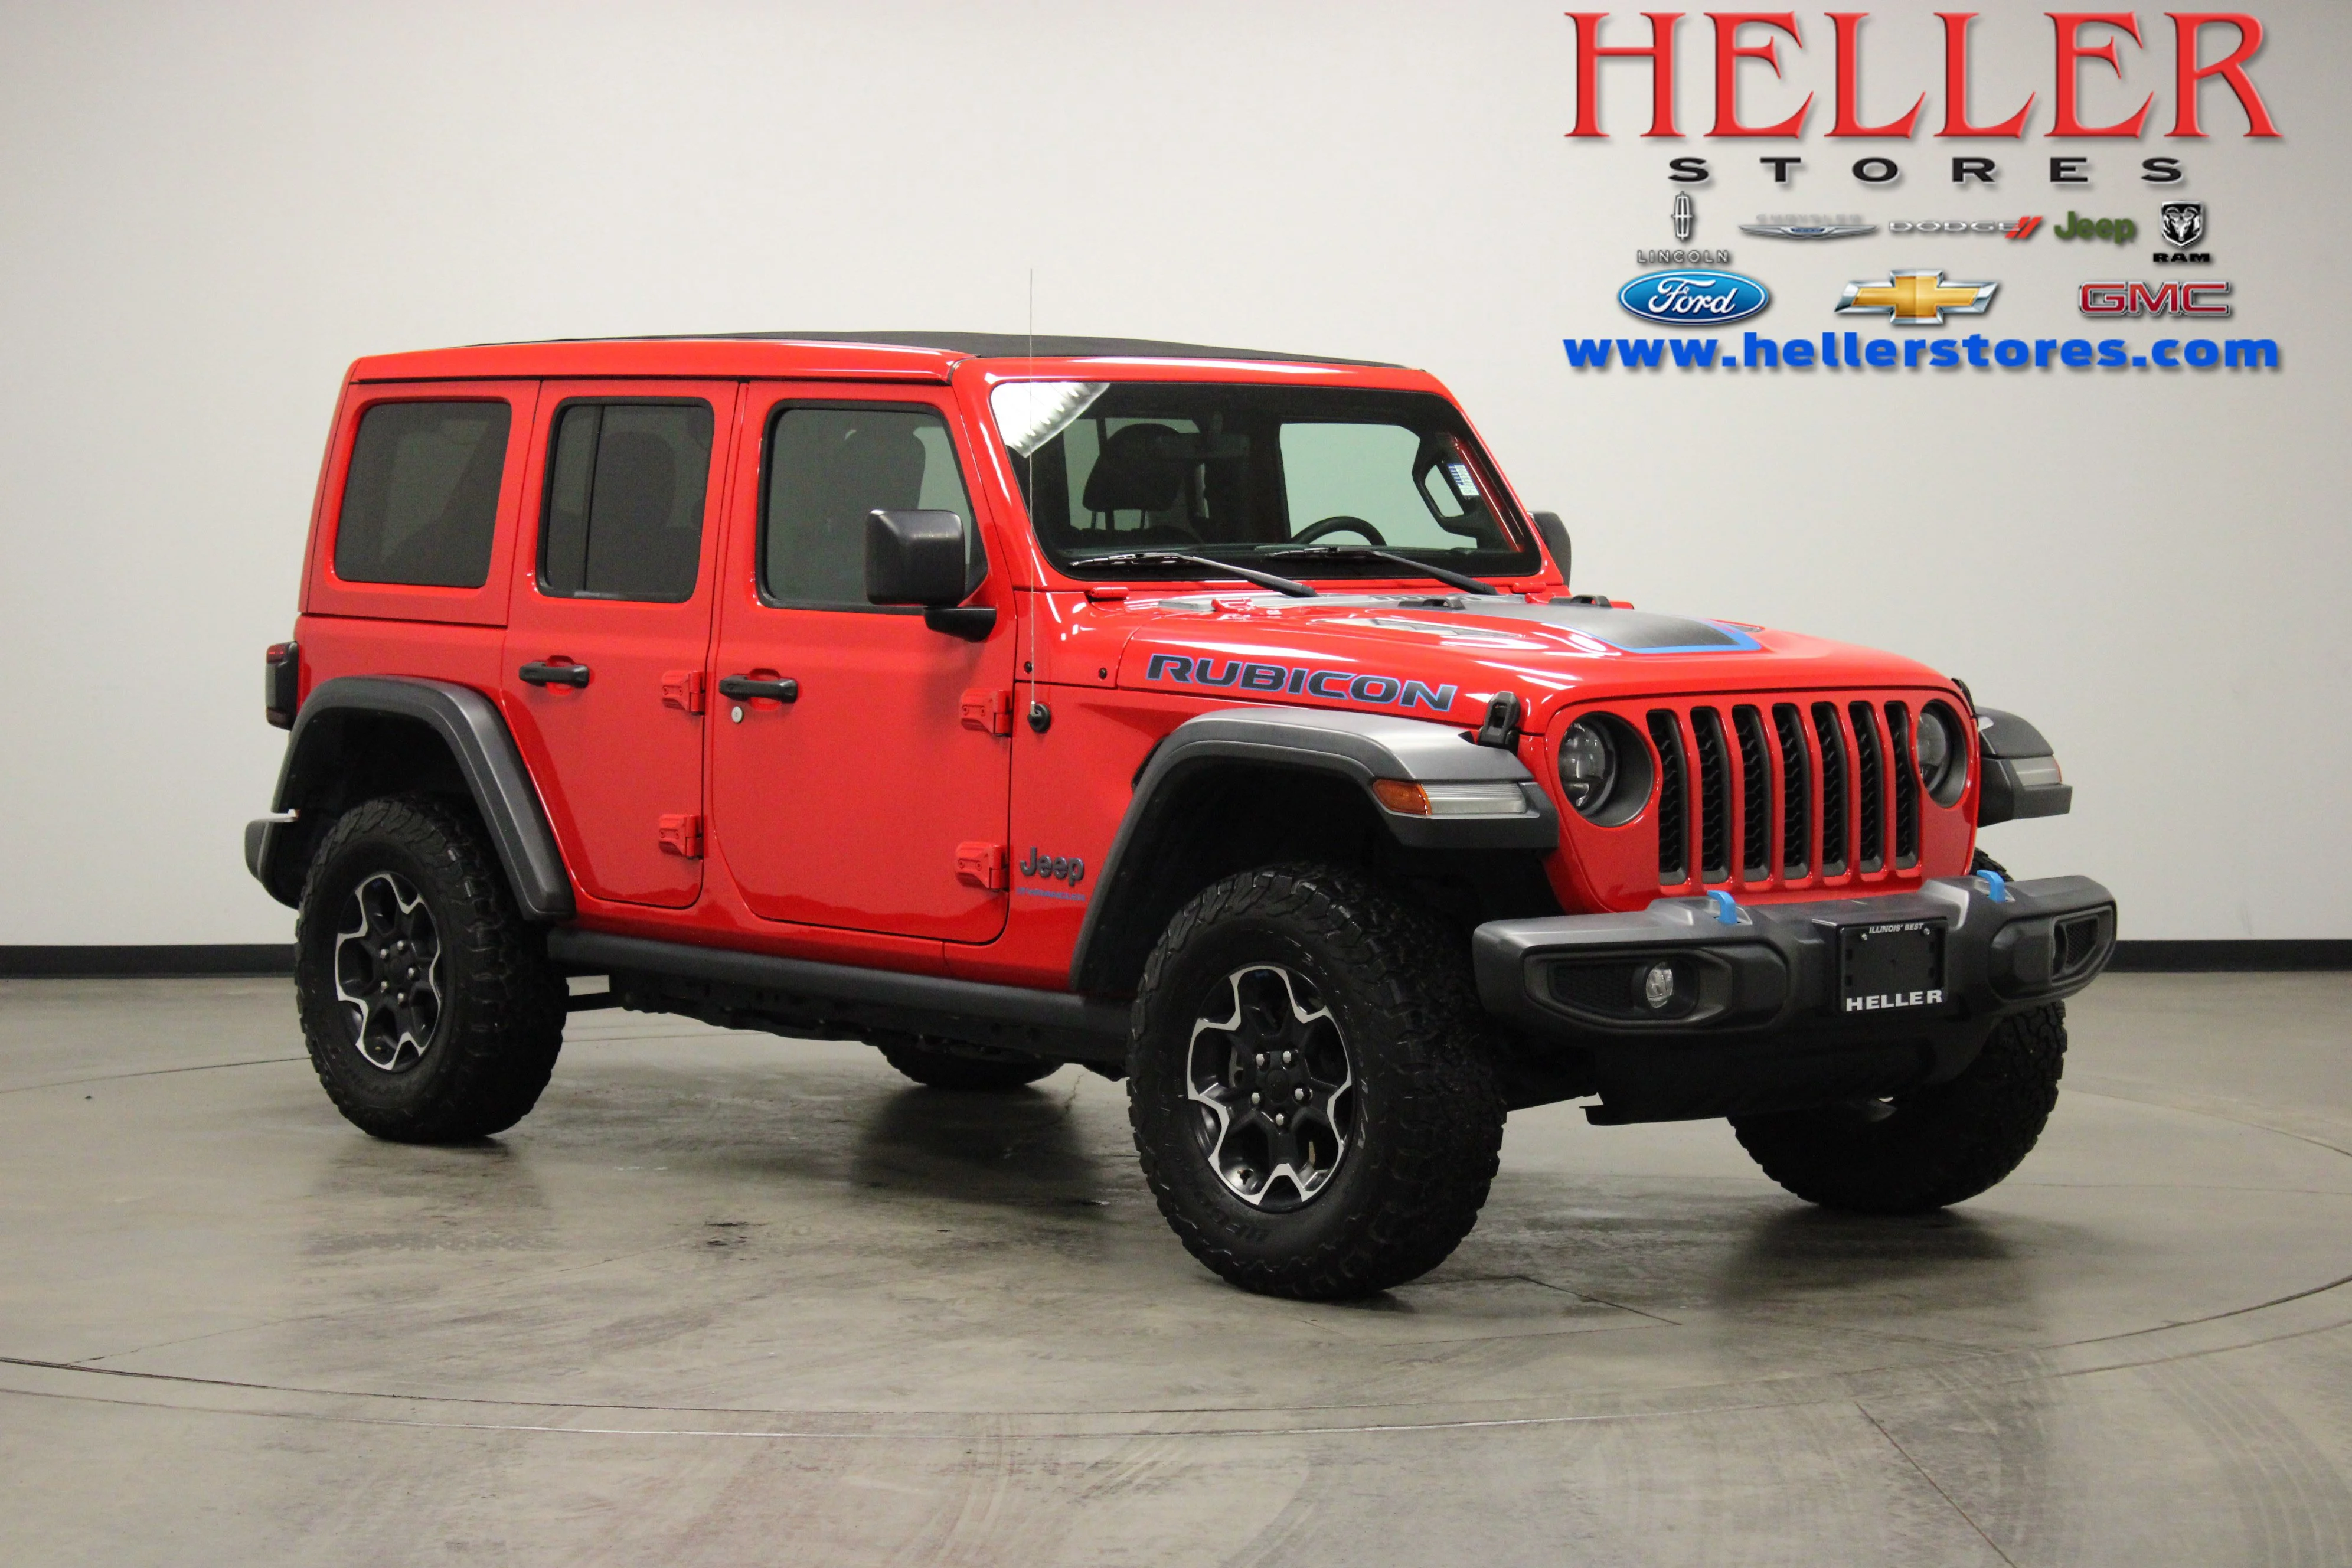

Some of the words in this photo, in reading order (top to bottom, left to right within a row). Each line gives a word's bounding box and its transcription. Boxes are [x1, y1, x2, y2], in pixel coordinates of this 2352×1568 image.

[1146, 653, 1458, 711] RUBICON
[1020, 846, 1084, 887] Jeep
[1905, 923, 1923, 931] BEST
[1846, 989, 1942, 1011] HELLER
